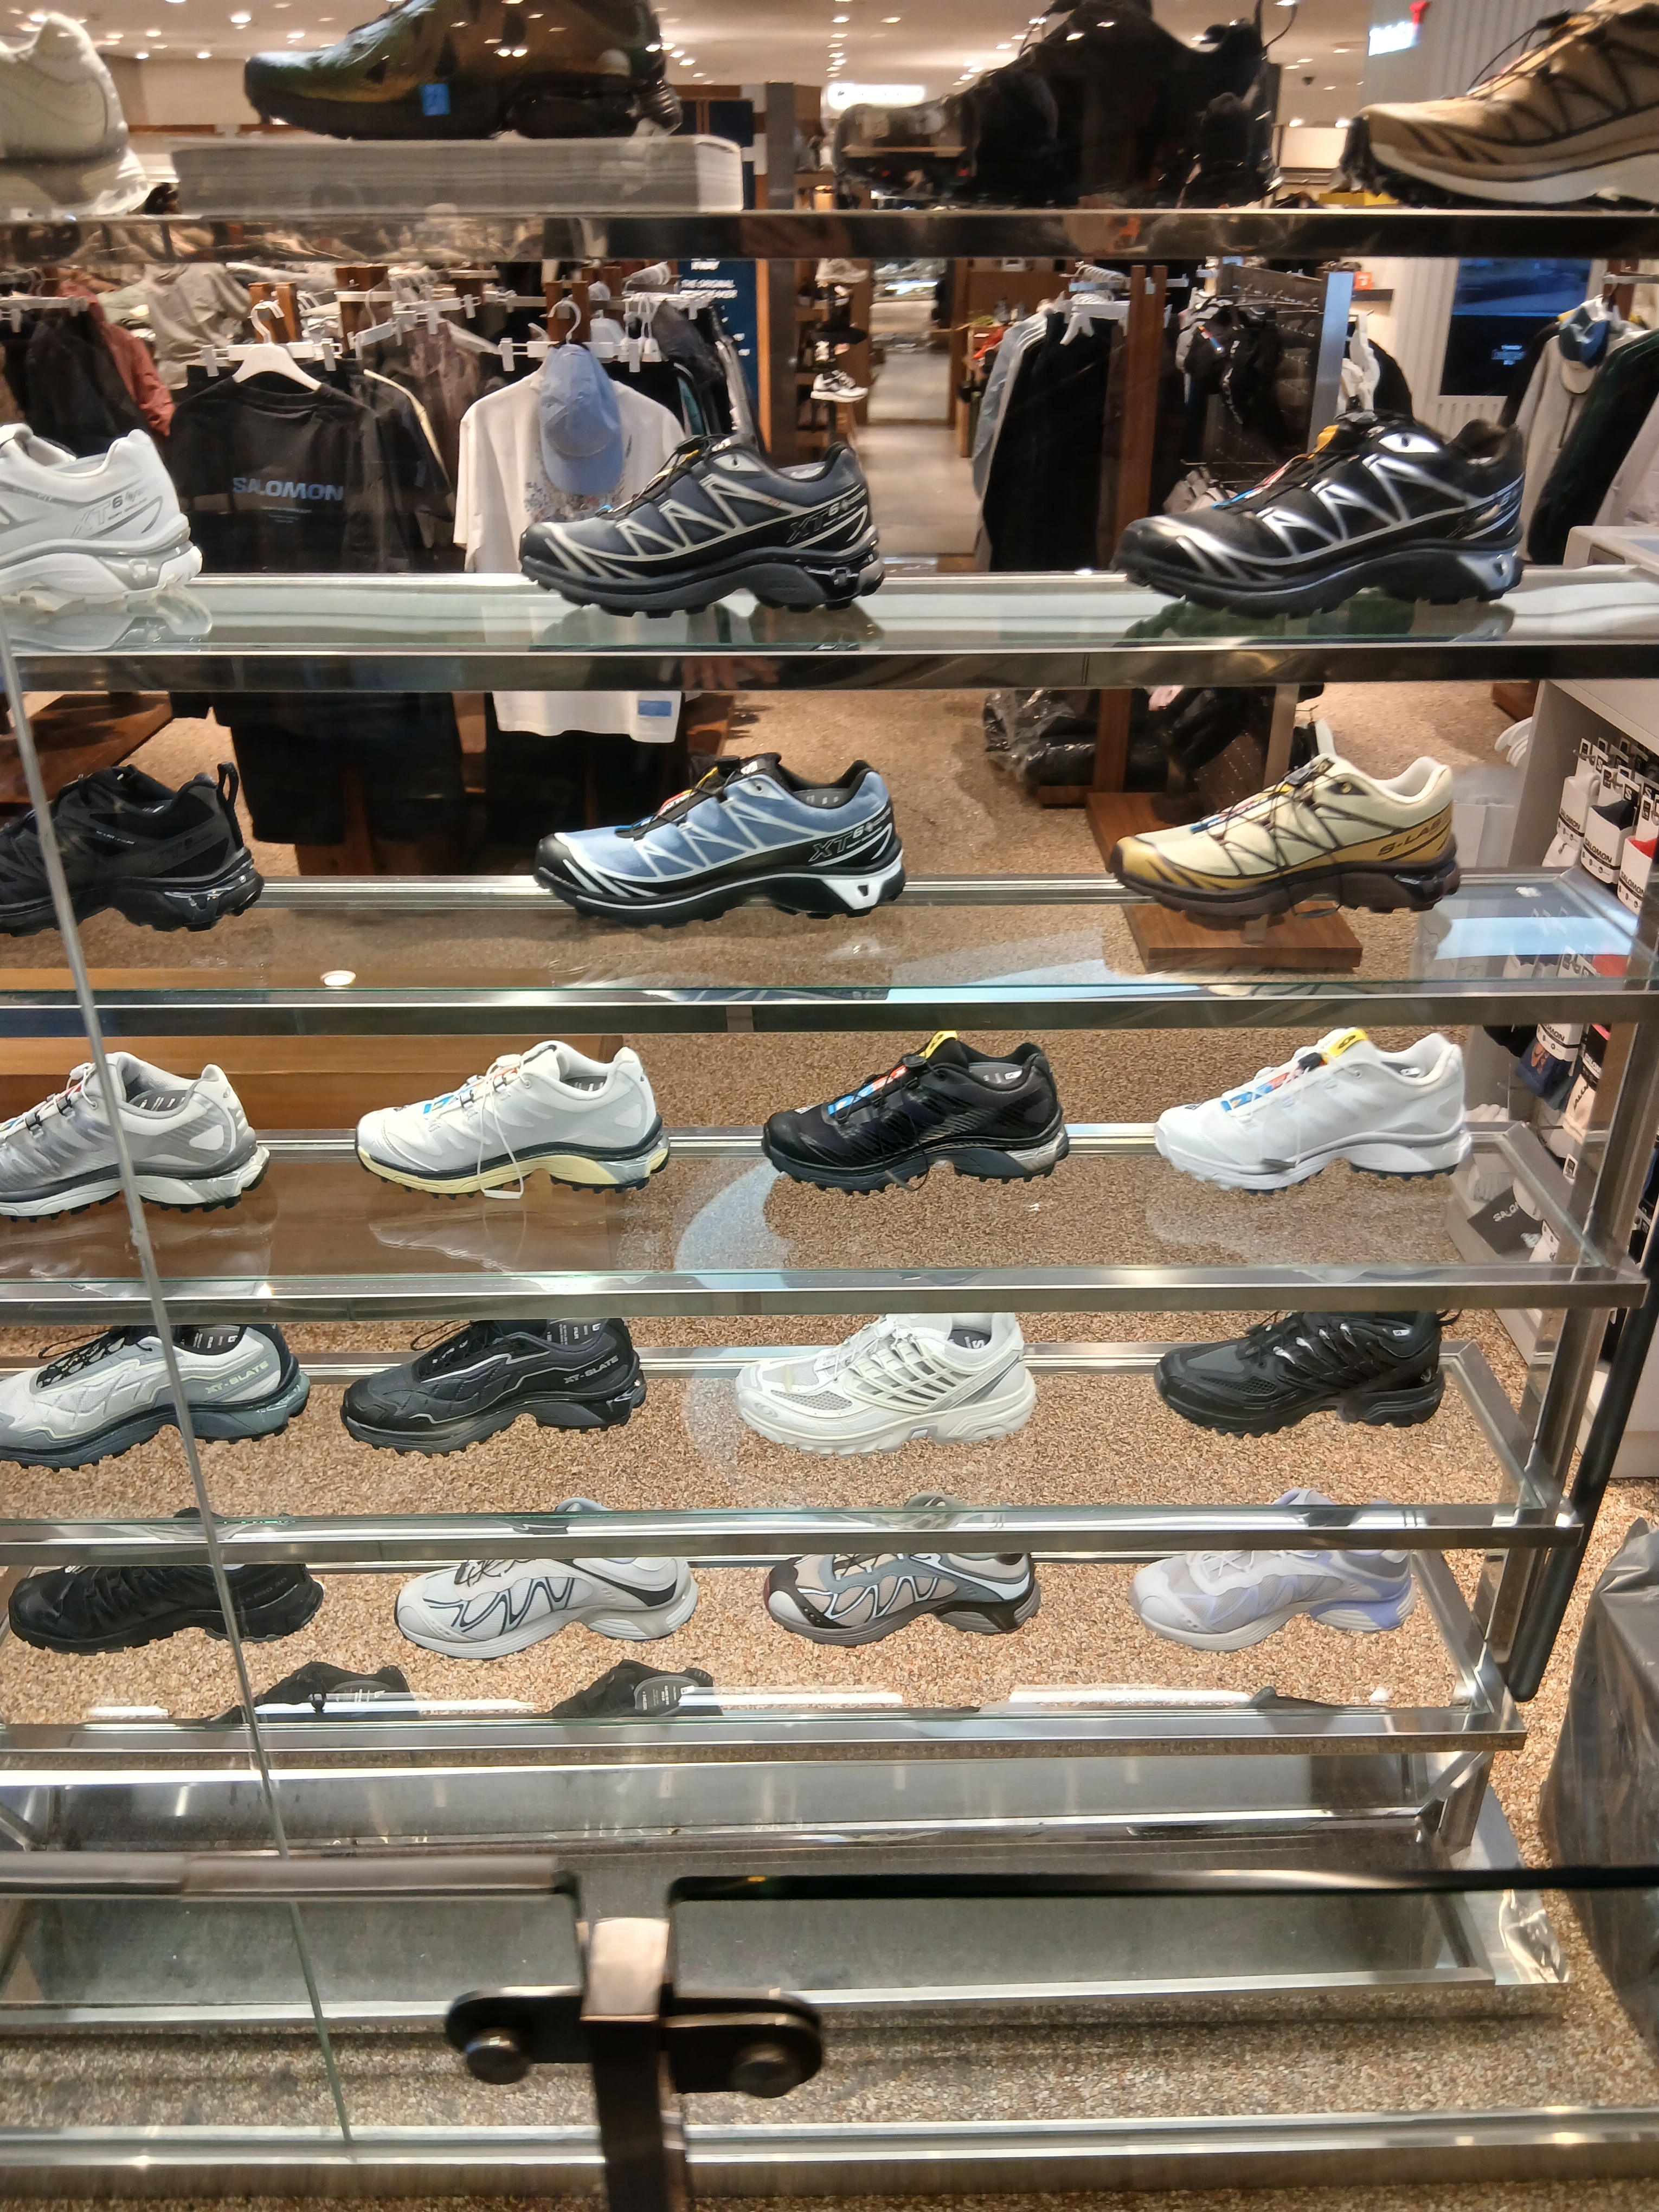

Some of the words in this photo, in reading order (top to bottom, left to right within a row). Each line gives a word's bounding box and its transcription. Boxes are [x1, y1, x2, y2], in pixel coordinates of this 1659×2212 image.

[233, 477, 343, 501] SALOMON
[1625, 788, 1632, 800] S
[1585, 838, 1613, 863] SALOMON
